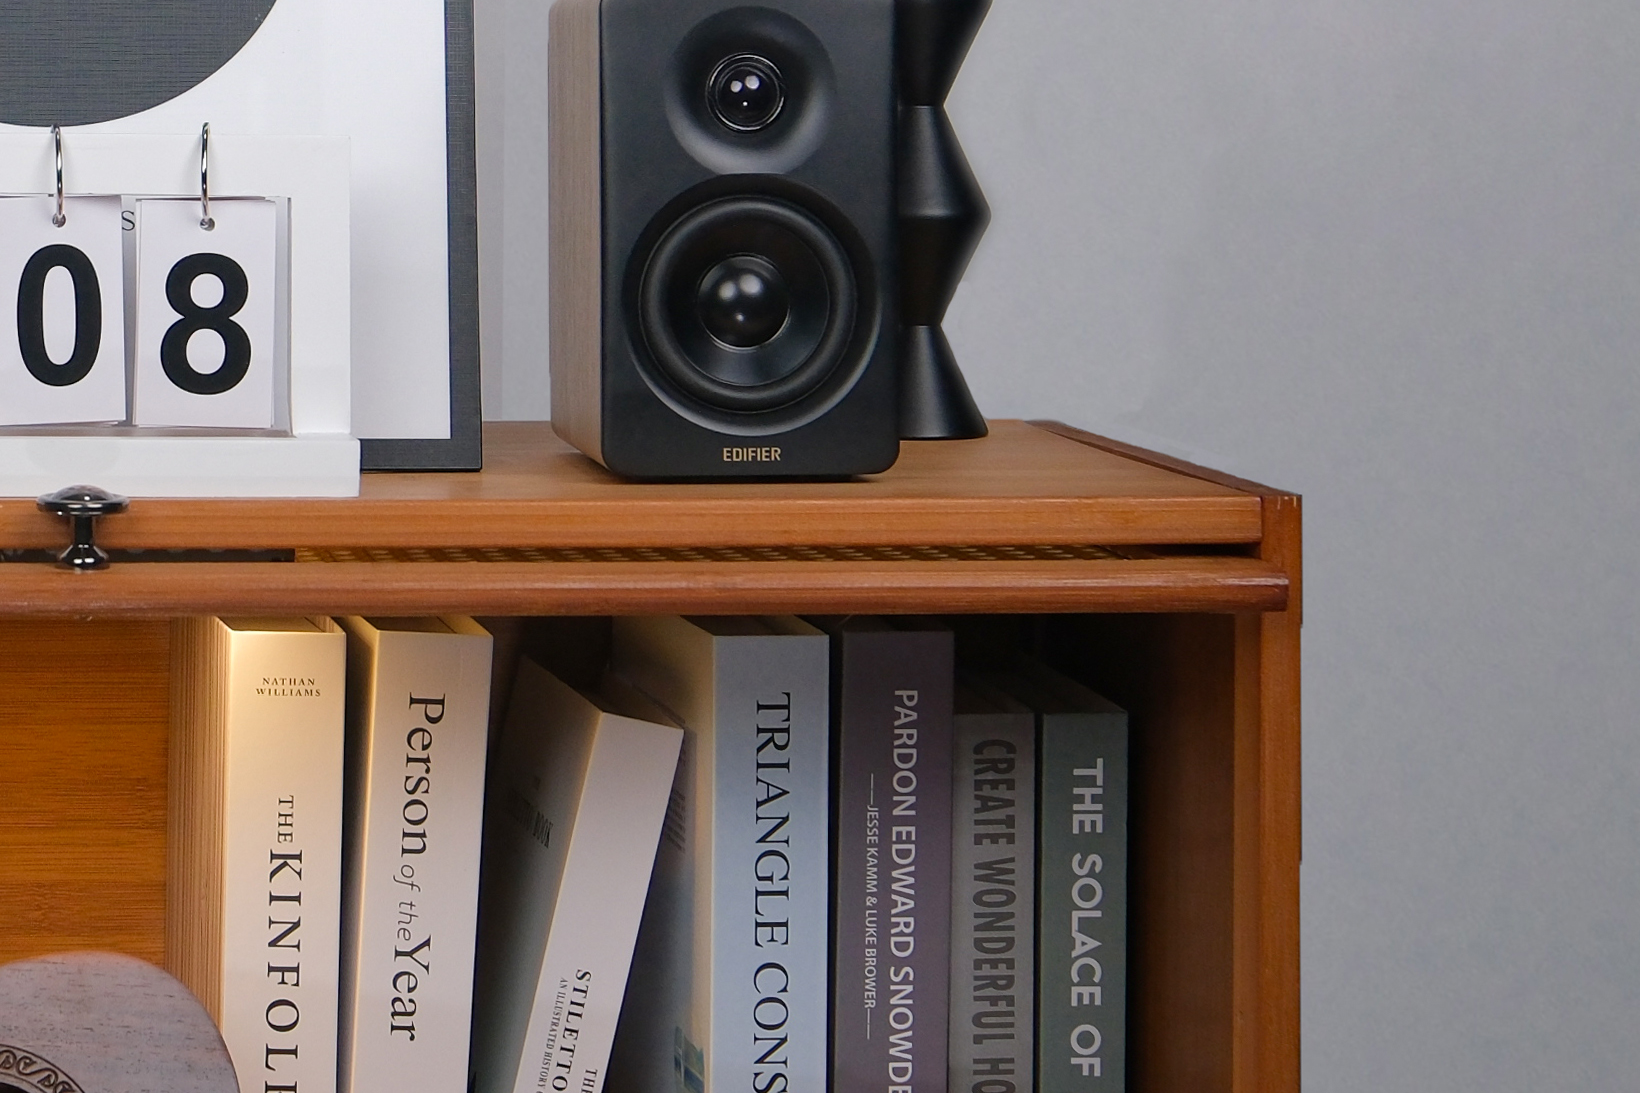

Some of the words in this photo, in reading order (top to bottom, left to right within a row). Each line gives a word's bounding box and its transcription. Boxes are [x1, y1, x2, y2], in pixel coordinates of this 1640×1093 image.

[723, 447, 781, 462] EDIFIER
[256, 688, 321, 697] WILLIAMS
[262, 677, 315, 686] NATHAN
[401, 692, 446, 858] Person
[891, 689, 918, 816] PARDON
[277, 794, 295, 844] THE
[754, 691, 791, 948] TRIANGLE
[972, 739, 1017, 846] CREATE
[1072, 758, 1103, 835] THE
[866, 805, 879, 844] JESSE
[393, 863, 421, 892] of
[865, 847, 879, 893] KAMM
[889, 824, 917, 958] EDWARD
[397, 900, 419, 941] the
[865, 896, 878, 907] &
[865, 909, 878, 945] LUKE
[1070, 852, 1103, 1007] SOLACE
[971, 856, 1017, 1045] WONDERFUL
[390, 934, 432, 1042] Year
[559, 977, 568, 990] AN
[864, 948, 879, 1010] BROWER
[546, 991, 566, 1050] ILLUSTRATED
[552, 969, 592, 1092] STILETTO
[752, 961, 790, 1093] CONS
[536, 1051, 553, 1088] HISTORY
[1070, 1023, 1102, 1077] OF
